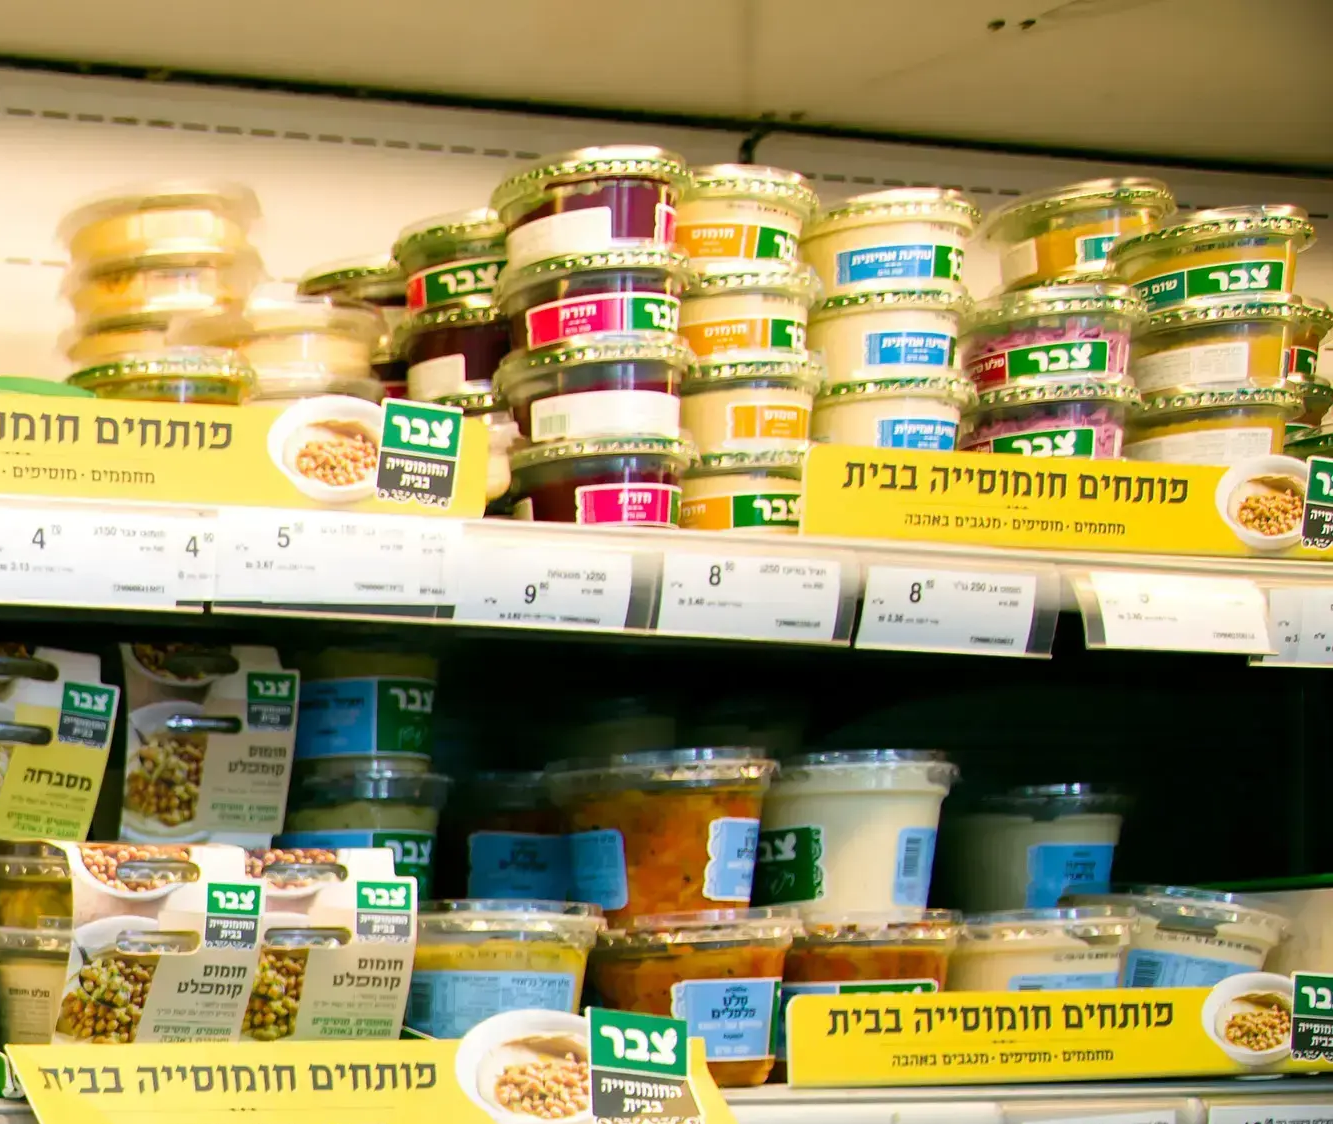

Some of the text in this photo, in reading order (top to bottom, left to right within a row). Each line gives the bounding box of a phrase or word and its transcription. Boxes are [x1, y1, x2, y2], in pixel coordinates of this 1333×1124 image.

[1208, 264, 1271, 290] צבר
[95, 416, 232, 449] פותחים
[392, 415, 453, 448] צבר
[12, 465, 78, 482] מוסיפים
[91, 470, 154, 483] מחממים
[386, 457, 448, 477] החומוסייה
[400, 474, 430, 488] בבית
[843, 462, 1188, 503] פותחים חומוסייה בבית
[203, 965, 247, 979] חומוס
[828, 1002, 1173, 1035] פותחים חומוסייה בבית
[600, 1025, 677, 1065] צבר
[38, 1063, 436, 1093] פותחים חומוסייה בבית
